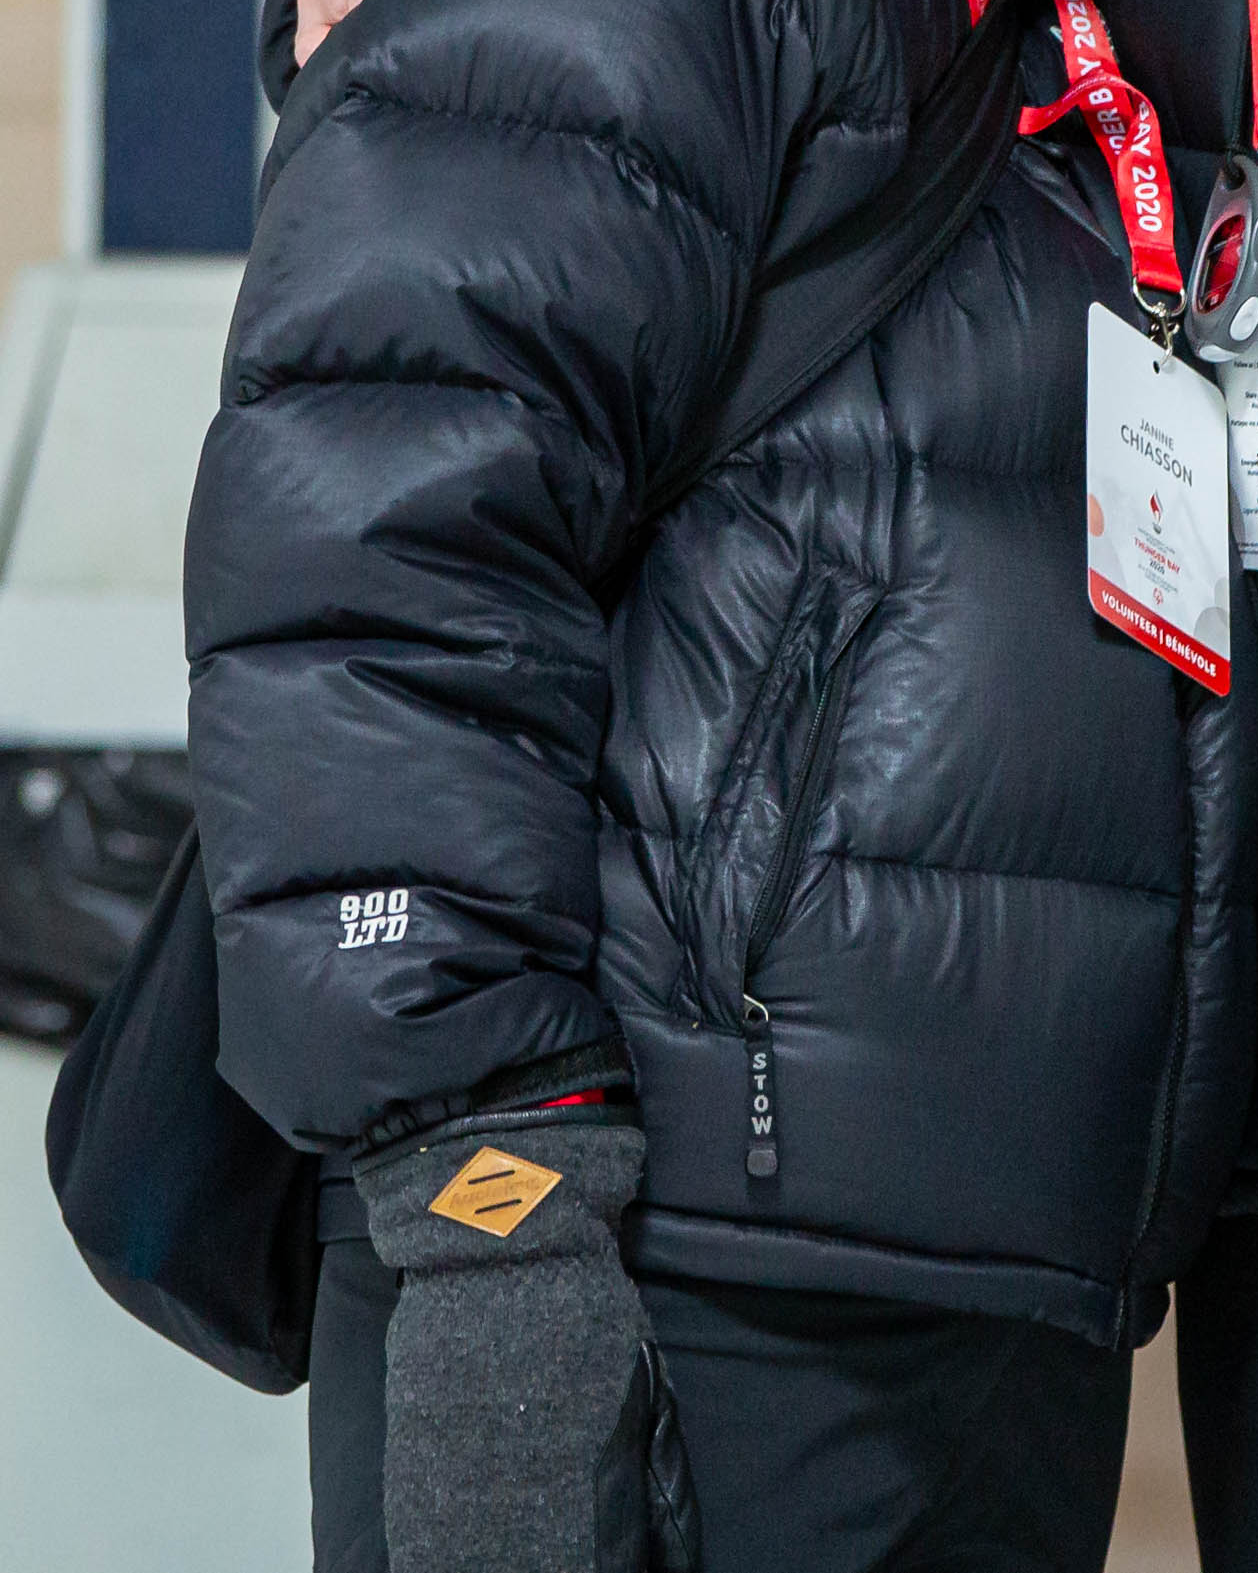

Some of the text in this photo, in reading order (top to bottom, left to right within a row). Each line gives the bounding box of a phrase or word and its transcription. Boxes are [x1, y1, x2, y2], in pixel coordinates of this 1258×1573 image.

[1130, 102, 1163, 232] BAY 2020
[1121, 424, 1192, 487] CHIASSON
[1140, 418, 1174, 451] JANINE
[1102, 590, 1158, 639] VOLUNTEER
[1165, 634, 1217, 677] BÉNÉVOLE
[338, 913, 409, 949] LTD
[340, 889, 409, 922] 900
[752, 1052, 772, 1135] STOW
